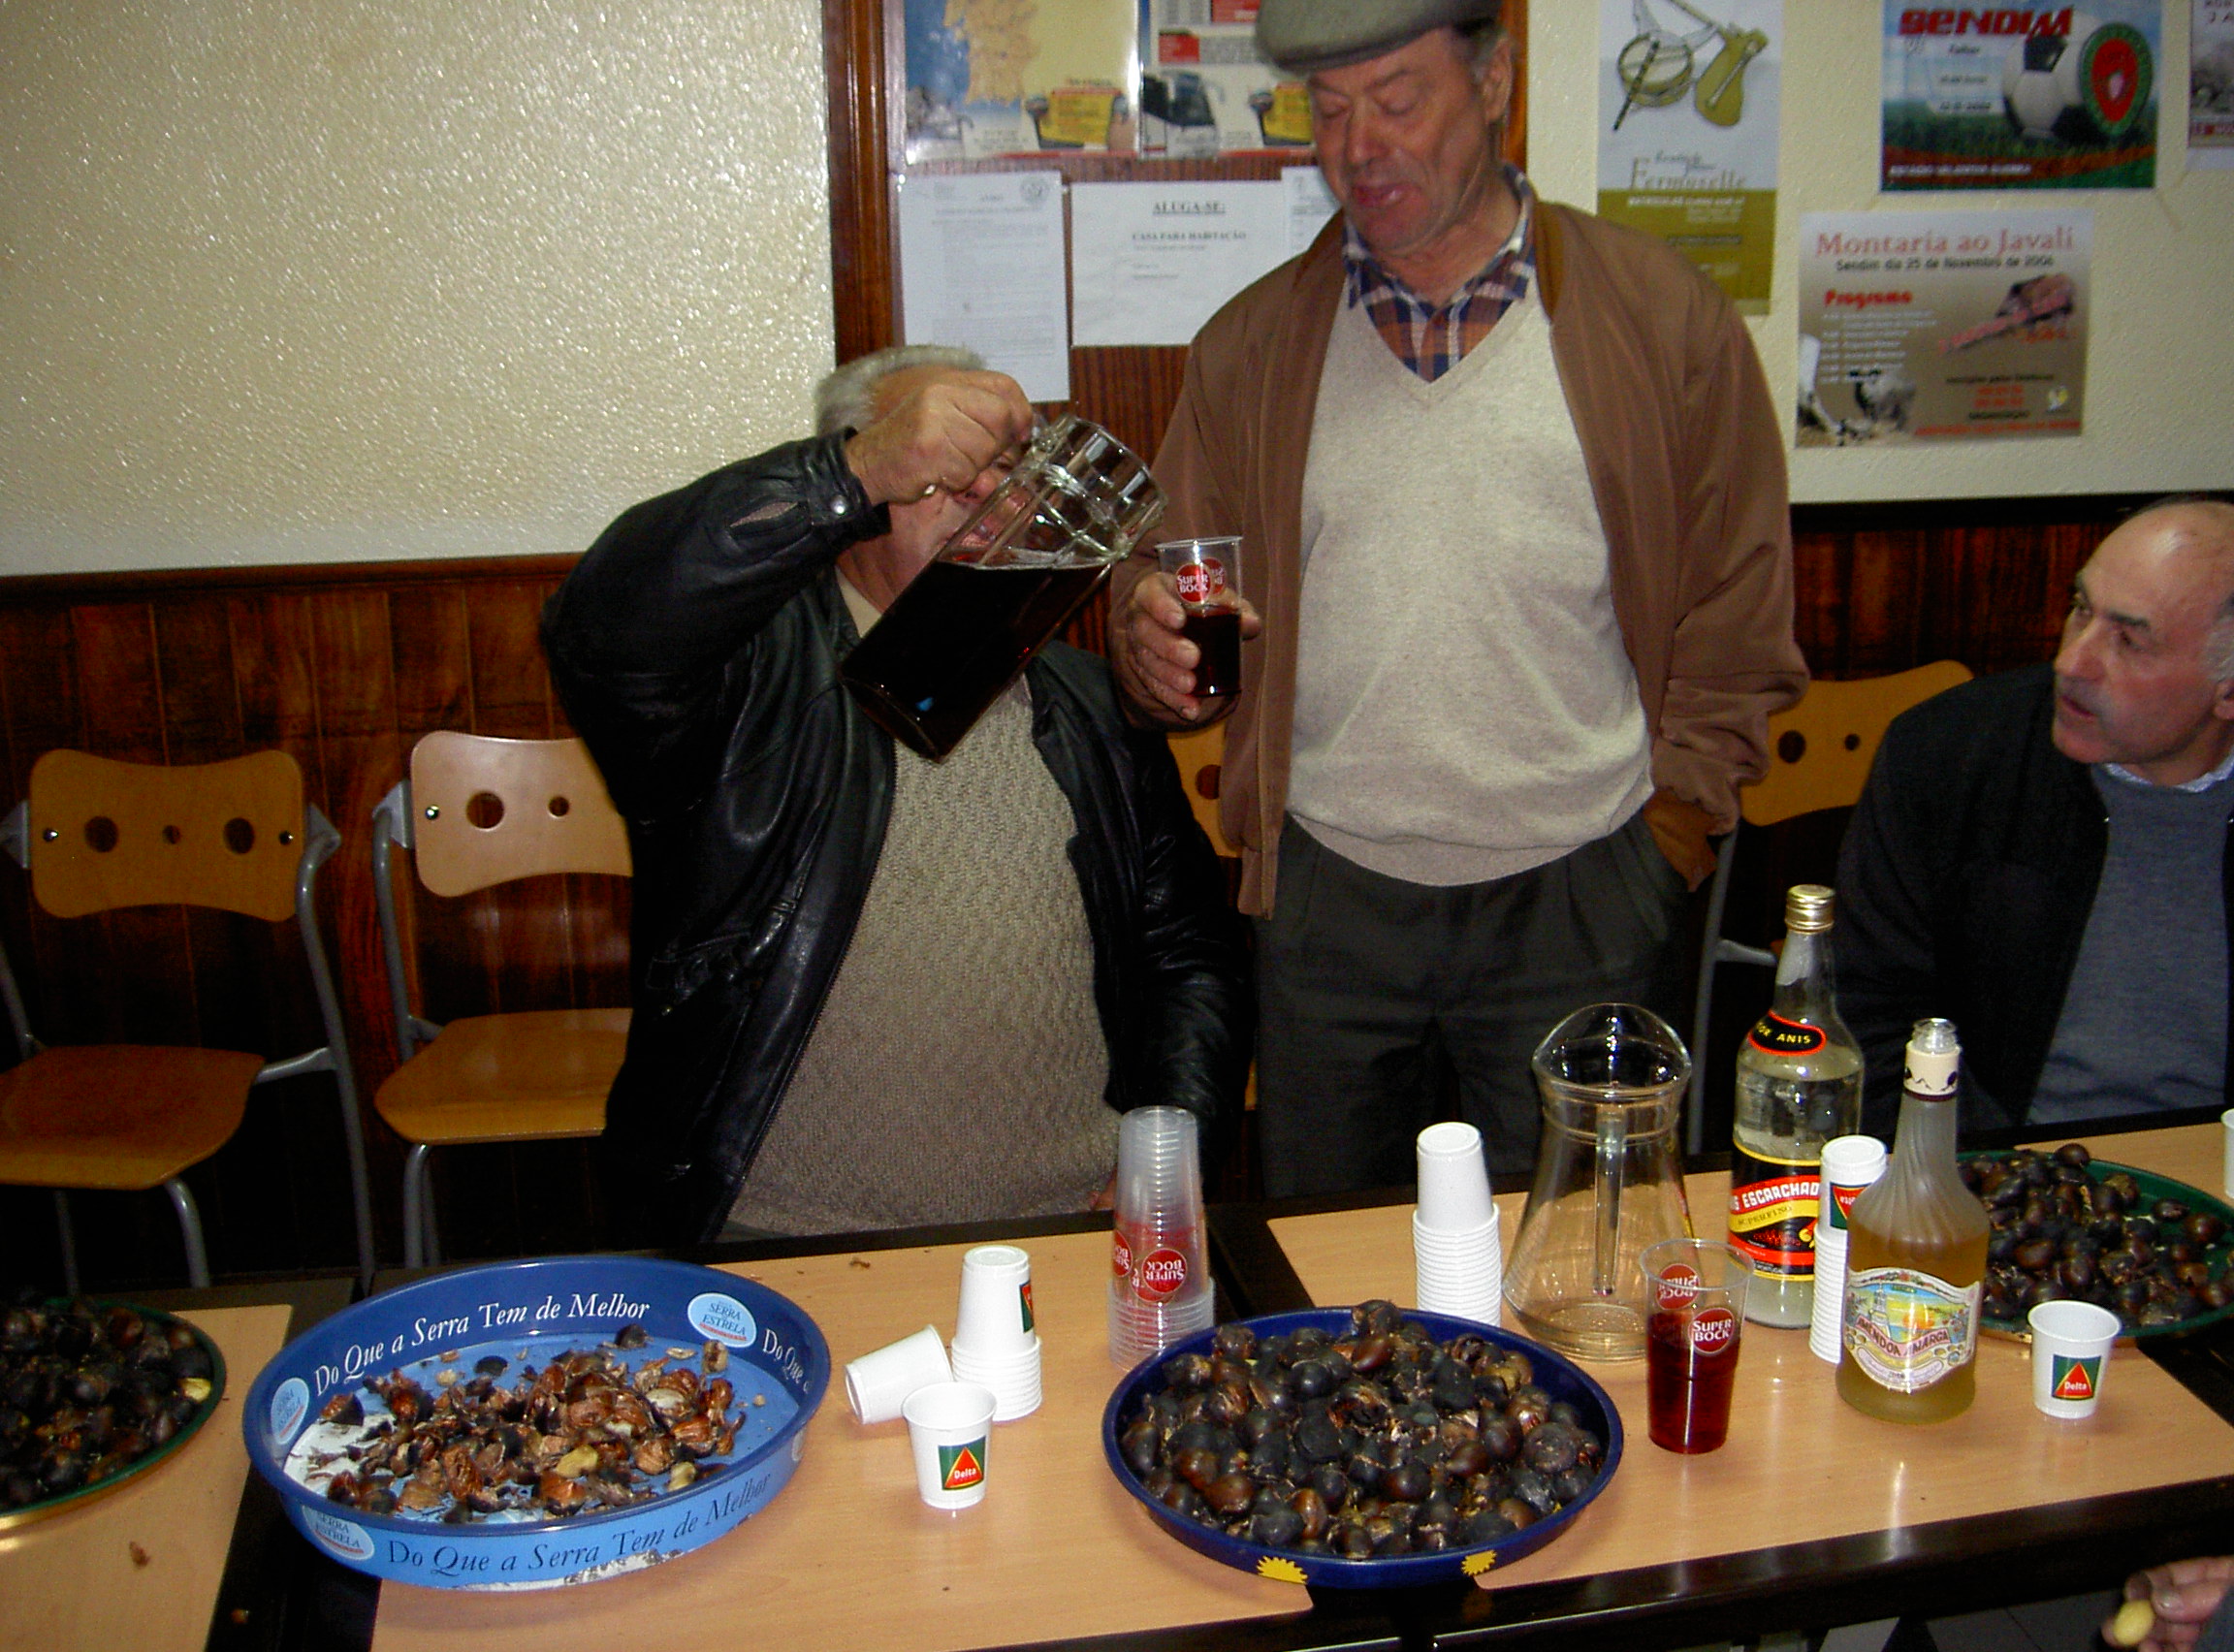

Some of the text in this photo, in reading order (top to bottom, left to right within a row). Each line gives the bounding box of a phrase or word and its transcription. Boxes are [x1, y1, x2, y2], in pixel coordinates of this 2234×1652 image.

[1816, 225, 2073, 258] Montaria ao Javali
[1835, 258, 1880, 271] Sendim
[1925, 256, 1939, 269] de
[2005, 254, 2020, 267] de
[1179, 583, 1209, 593] BOCK
[1776, 1032, 1811, 1044] ANIS
[1741, 1181, 1821, 1208] ESCARCHAD
[1146, 1259, 1183, 1271] BOCK
[1145, 1268, 1185, 1281] SUPER
[709, 1302, 741, 1320] SERRA
[702, 1314, 746, 1335] ESTRELA
[1693, 1318, 1732, 1332] SUPER
[1694, 1329, 1730, 1342] BOCK
[314, 1292, 651, 1396] Do Que a Serra Tem de Melhor
[762, 1328, 782, 1361] Do
[782, 1347, 804, 1384] Que
[2064, 1381, 2087, 1390] Delta
[954, 1468, 976, 1479] Delta
[388, 1540, 423, 1567] Do
[431, 1545, 489, 1577] Que
[500, 1555, 516, 1571] a
[527, 1543, 600, 1570] Serra
[612, 1528, 665, 1555] Tem
[674, 1510, 698, 1539] de
[705, 1474, 771, 1527] Melhor
